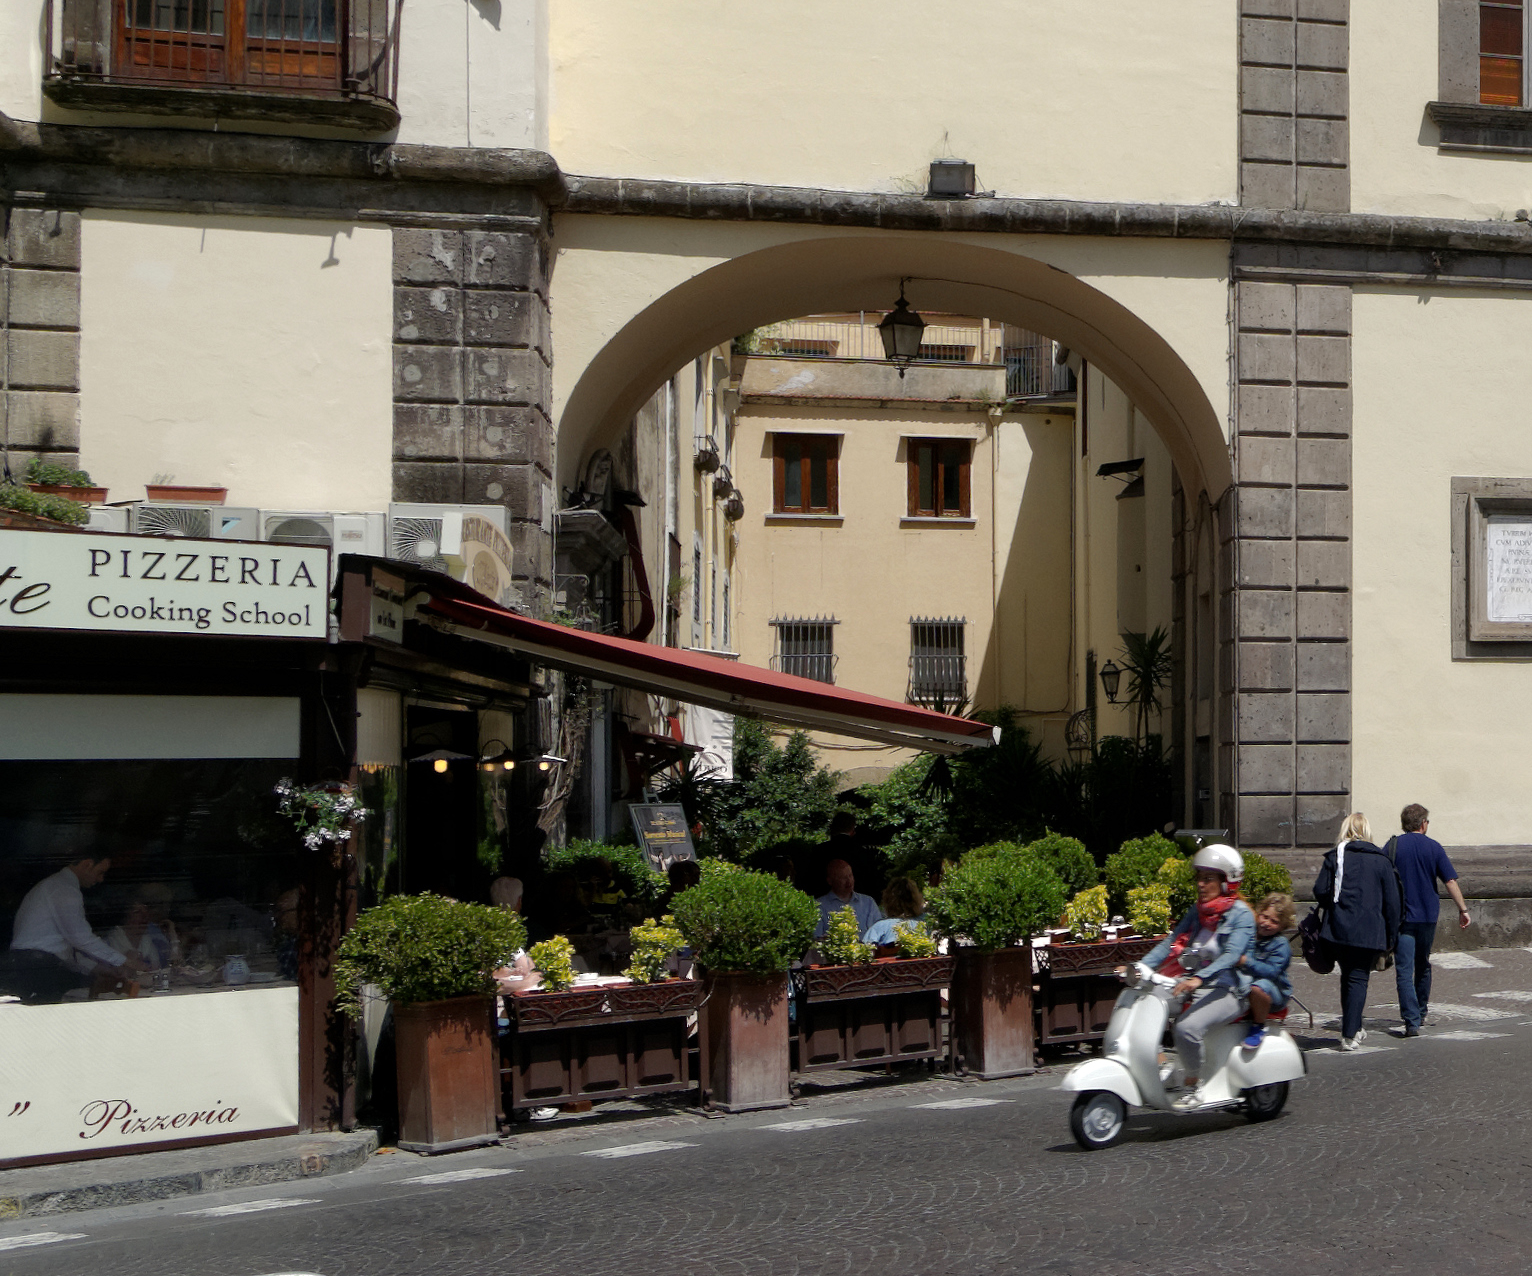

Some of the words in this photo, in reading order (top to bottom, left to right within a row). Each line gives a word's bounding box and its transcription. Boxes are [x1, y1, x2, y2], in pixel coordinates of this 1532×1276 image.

[88, 548, 317, 588] PIZZERIA
[87, 595, 212, 630] Cooking
[222, 600, 312, 627] School
[79, 1098, 241, 1140] Pizzeria
